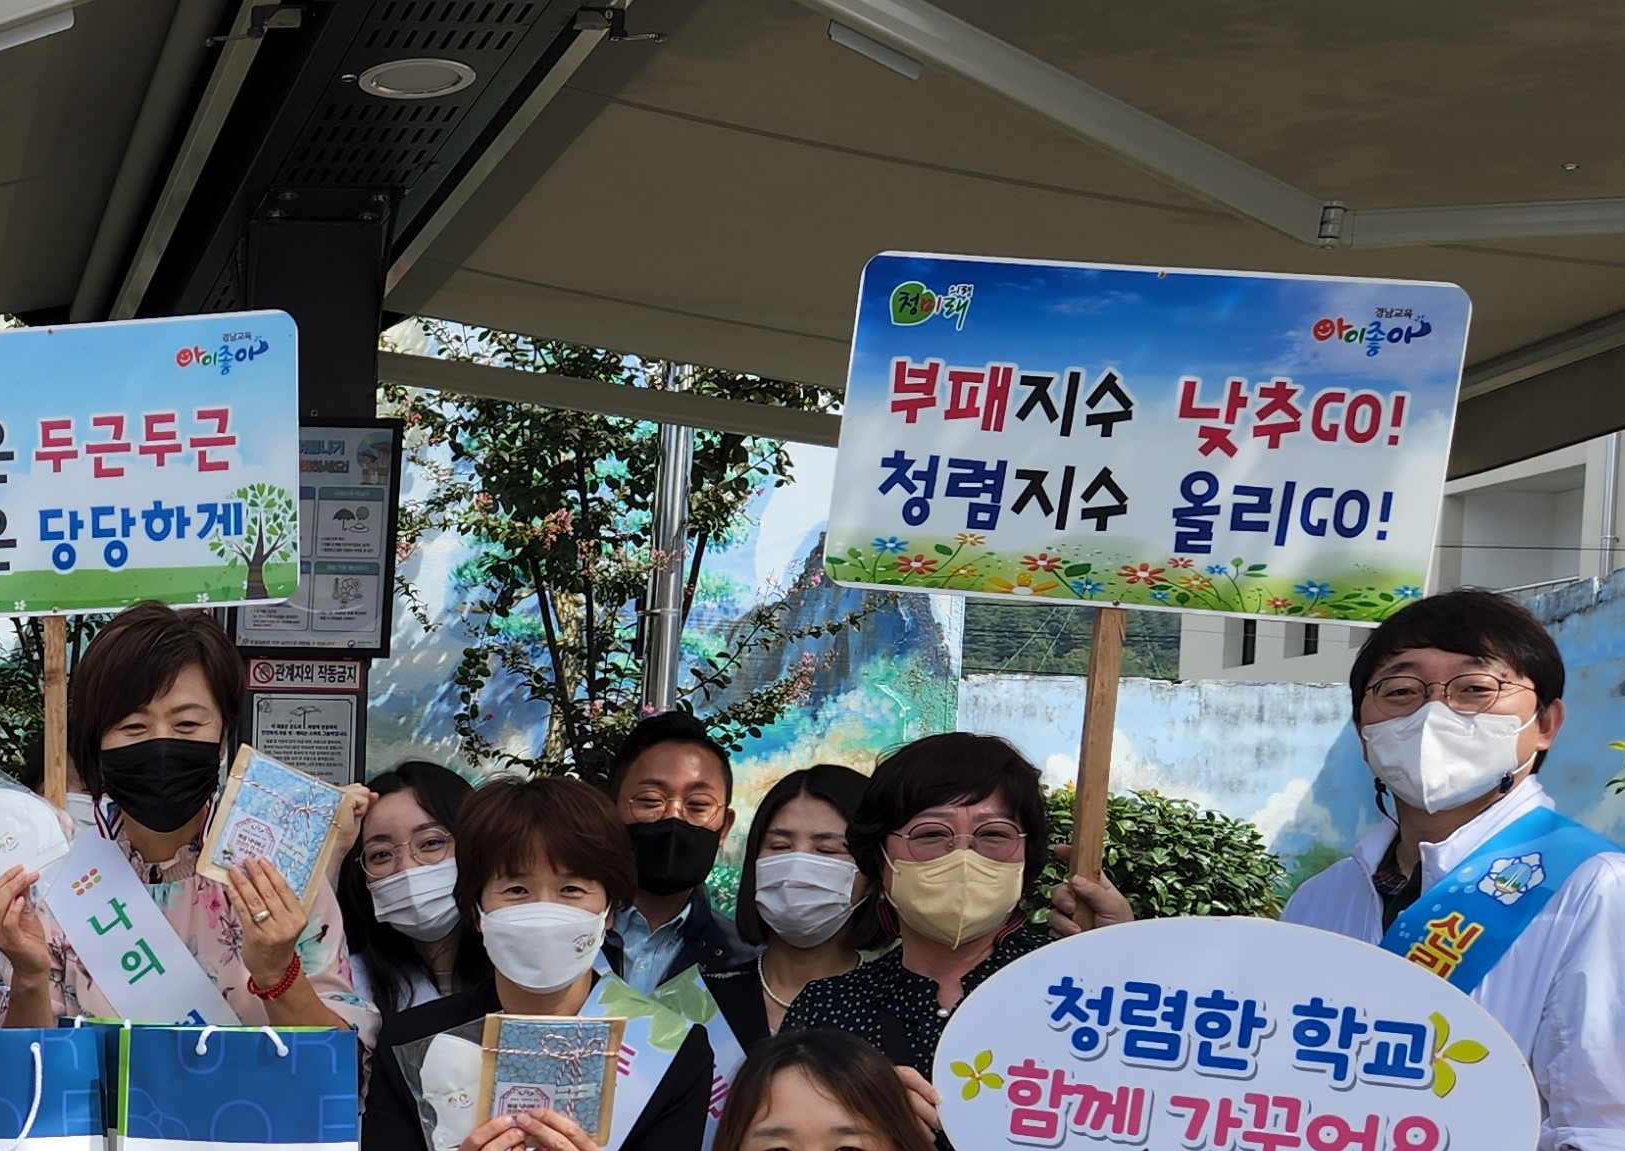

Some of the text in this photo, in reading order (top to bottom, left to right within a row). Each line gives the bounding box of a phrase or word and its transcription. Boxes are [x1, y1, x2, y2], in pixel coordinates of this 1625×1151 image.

[1313, 317, 1432, 357] 아이좋아
[1374, 307, 1414, 319] 경남교육
[176, 339, 269, 375] 아이좋아
[34, 408, 237, 479] 두근두근
[890, 360, 1407, 459] 부패지수 낮추GO!
[39, 500, 243, 571] 당당하게
[878, 450, 1394, 555] 청렴지수 올리GO!
[275, 663, 358, 684] 관계자외 작동금지
[87, 897, 166, 986] 나의
[1048, 977, 1429, 1082] 청렴한 학교
[1006, 1058, 1146, 1141] 함께
